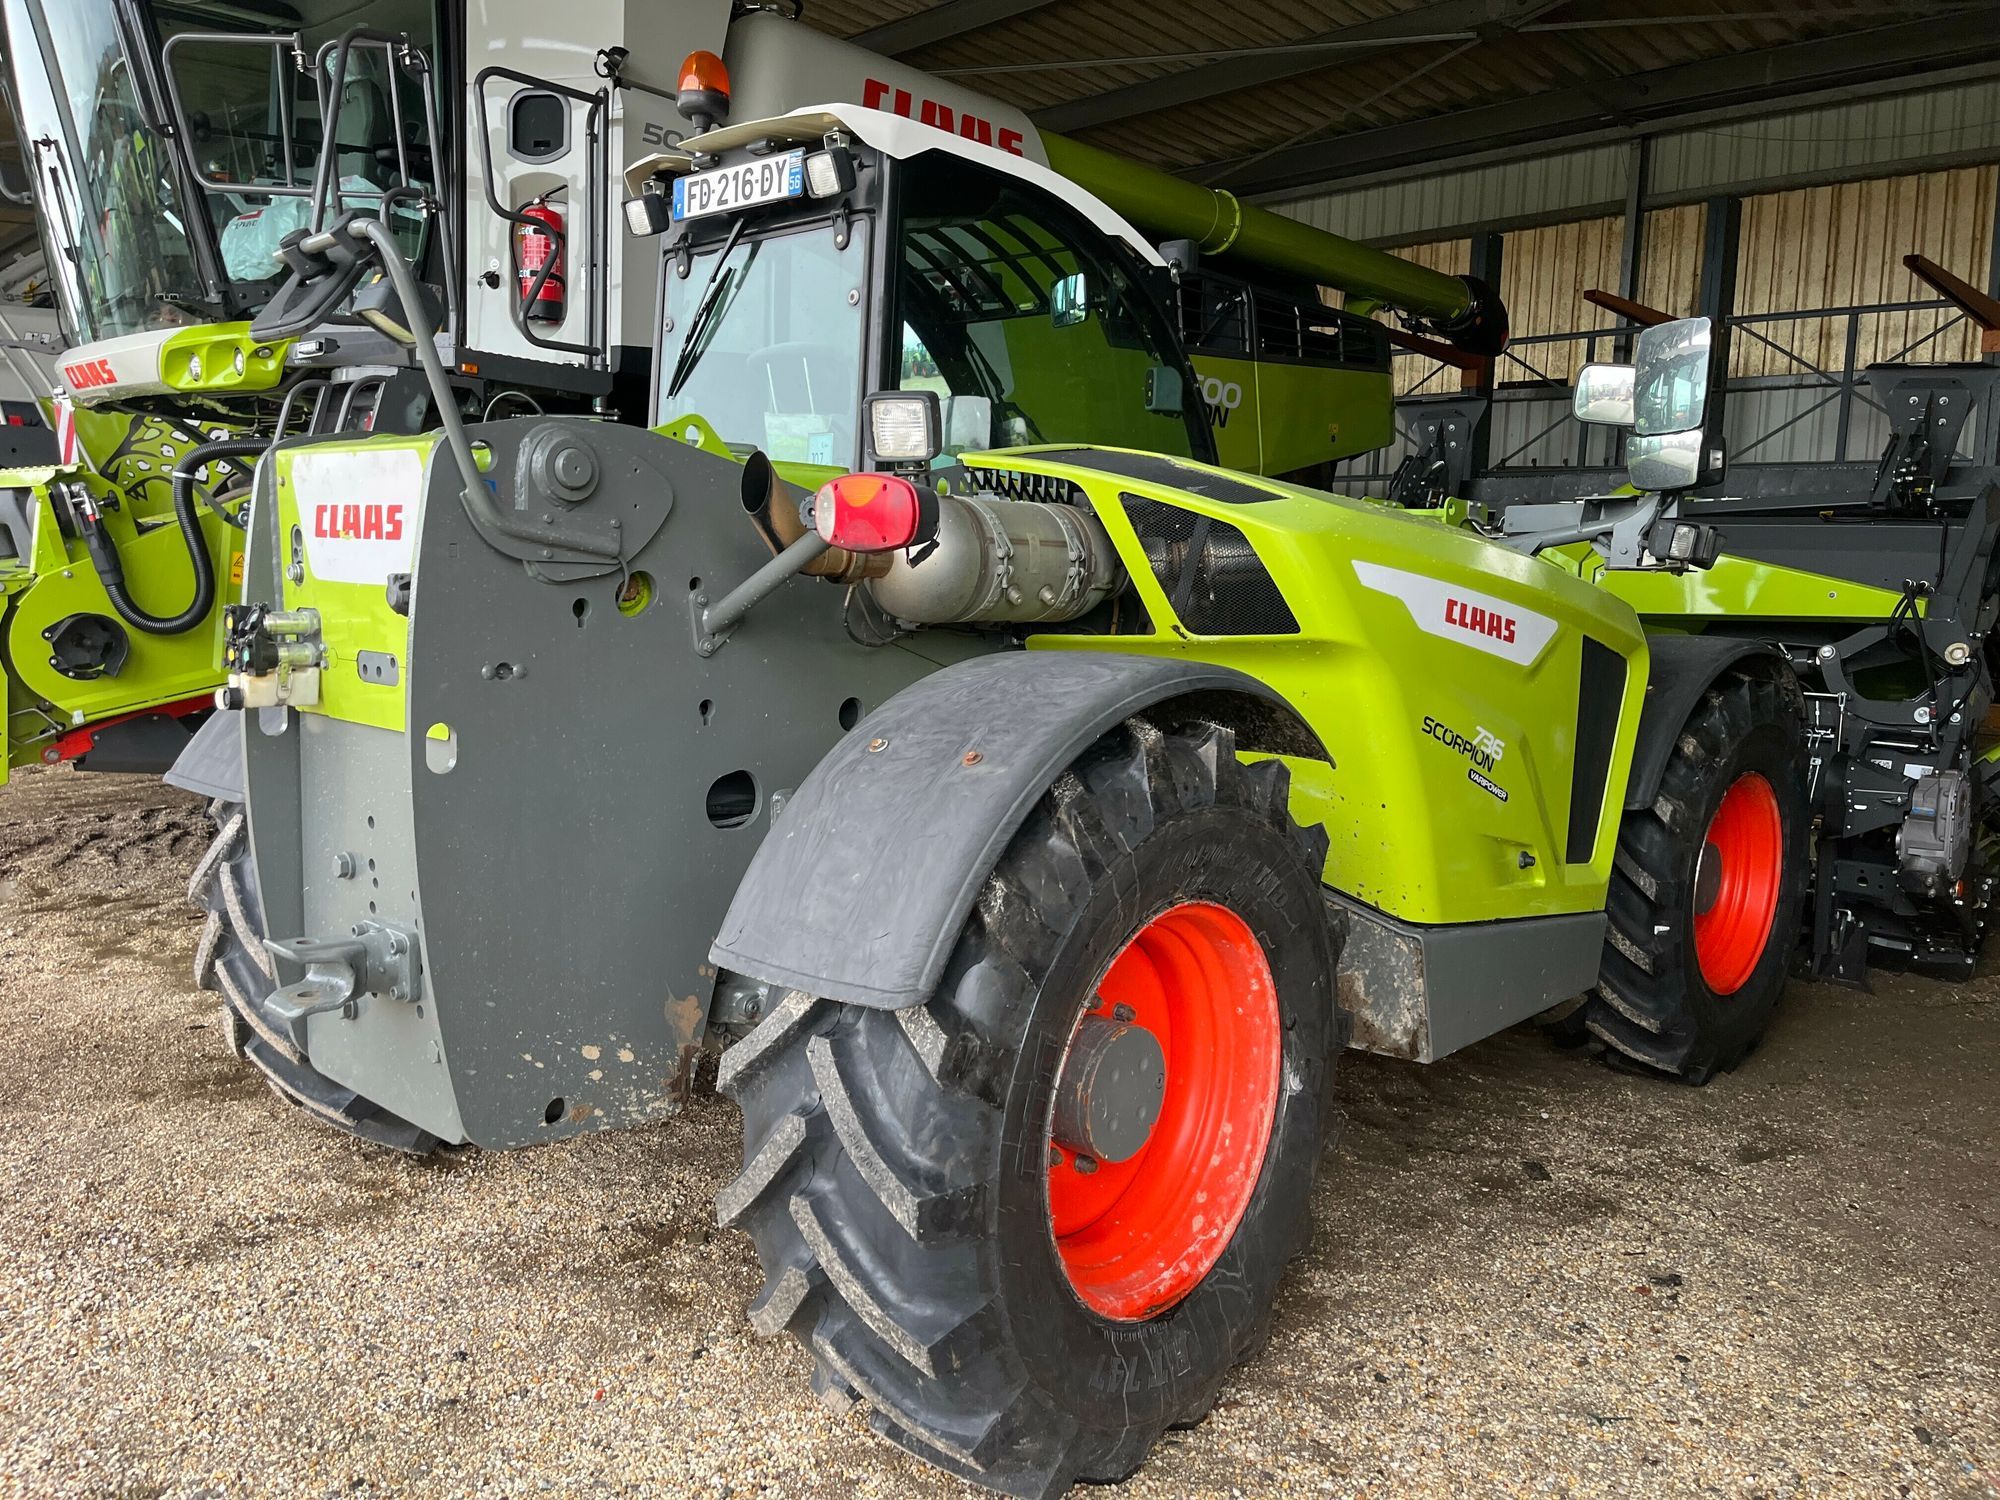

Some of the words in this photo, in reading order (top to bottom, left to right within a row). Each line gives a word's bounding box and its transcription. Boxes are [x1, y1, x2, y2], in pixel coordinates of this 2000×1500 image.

[642, 122, 697, 156] 50
[687, 159, 787, 213] FD-216-DY
[788, 175, 800, 190] 56
[64, 359, 118, 389] CLAAS
[1195, 373, 1242, 409] 00
[315, 504, 403, 540] CLAAS
[1445, 598, 1516, 644] CLAAS
[1421, 715, 1495, 773] SCORPION
[1472, 725, 1505, 760] 736
[1470, 769, 1507, 801] VARIPOWER
